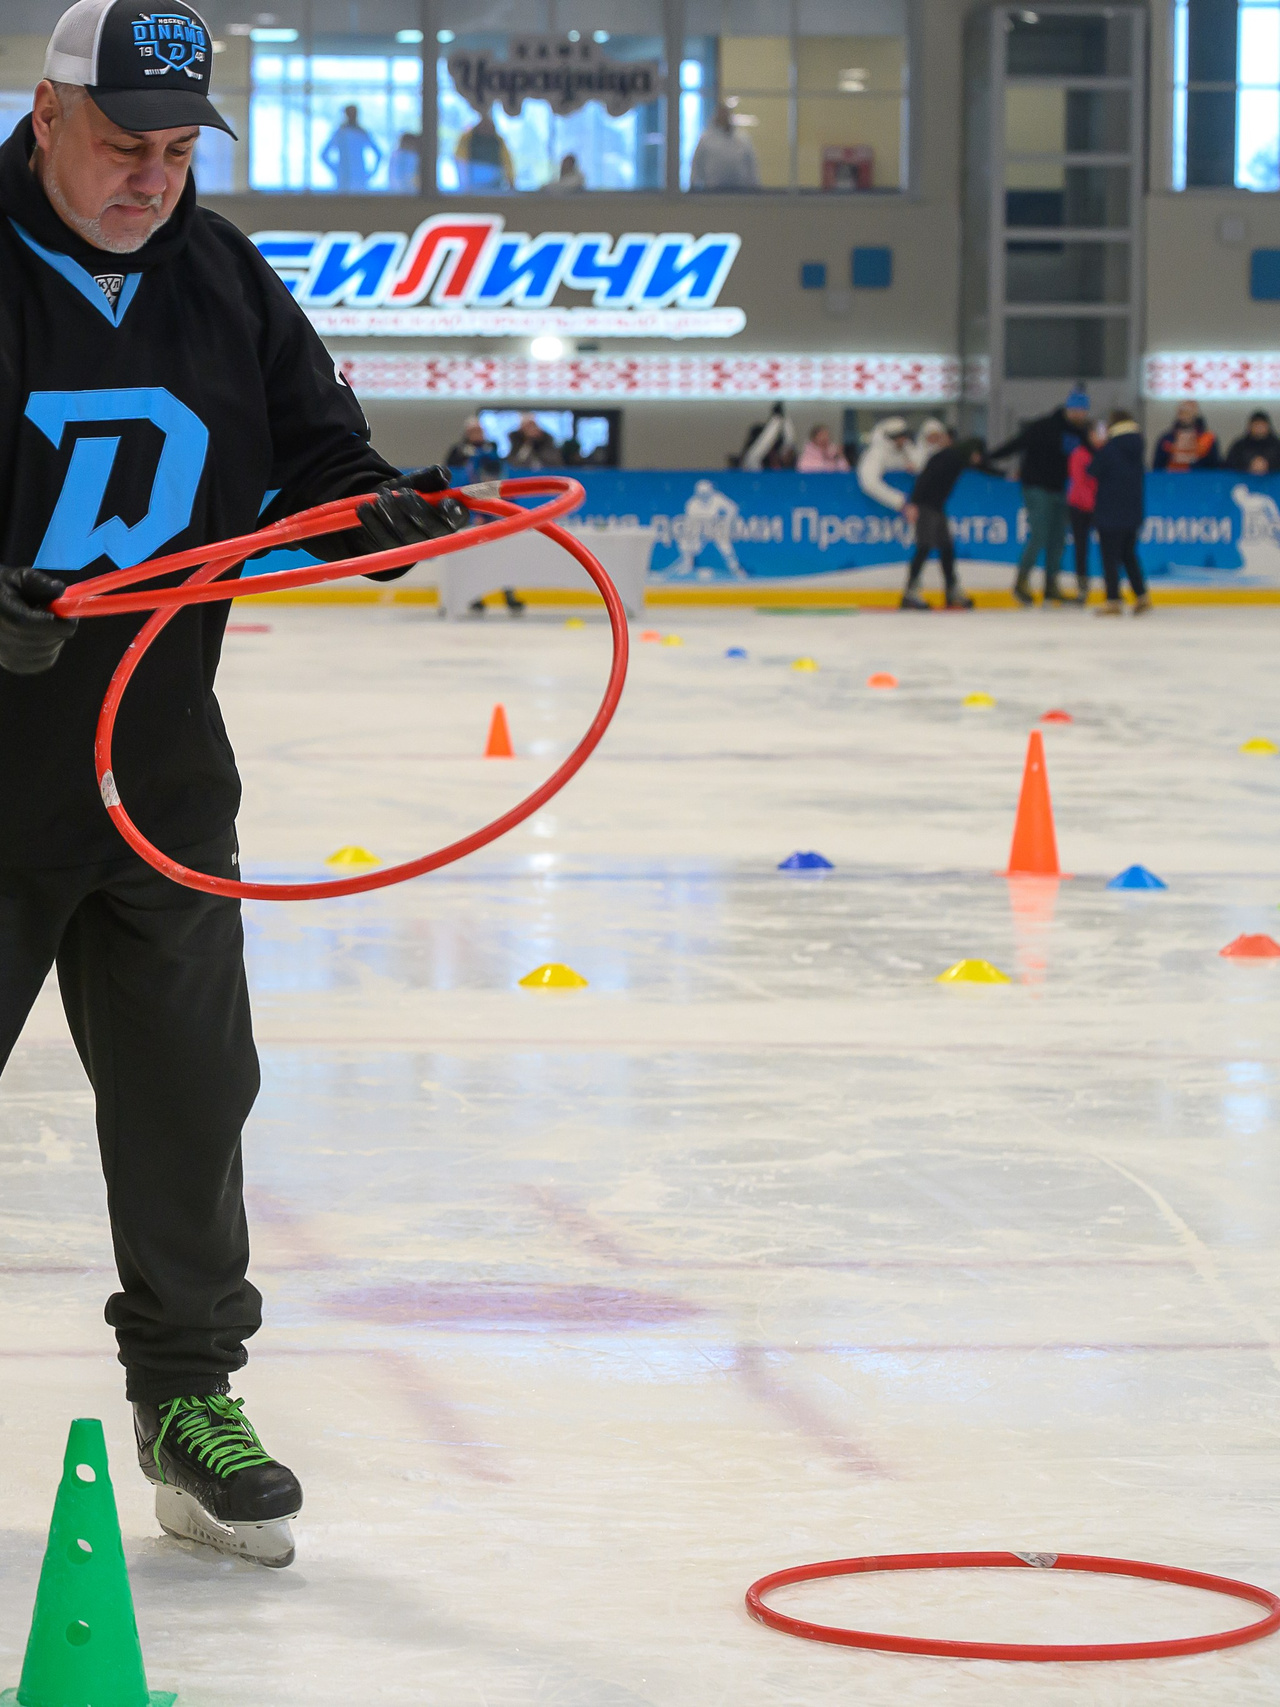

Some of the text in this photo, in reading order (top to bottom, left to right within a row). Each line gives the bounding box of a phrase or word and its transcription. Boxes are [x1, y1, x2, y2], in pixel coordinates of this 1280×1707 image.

[133, 24, 206, 46] DINAMO
[139, 46, 154, 57] 19
[791, 506, 1009, 551] Президнта
